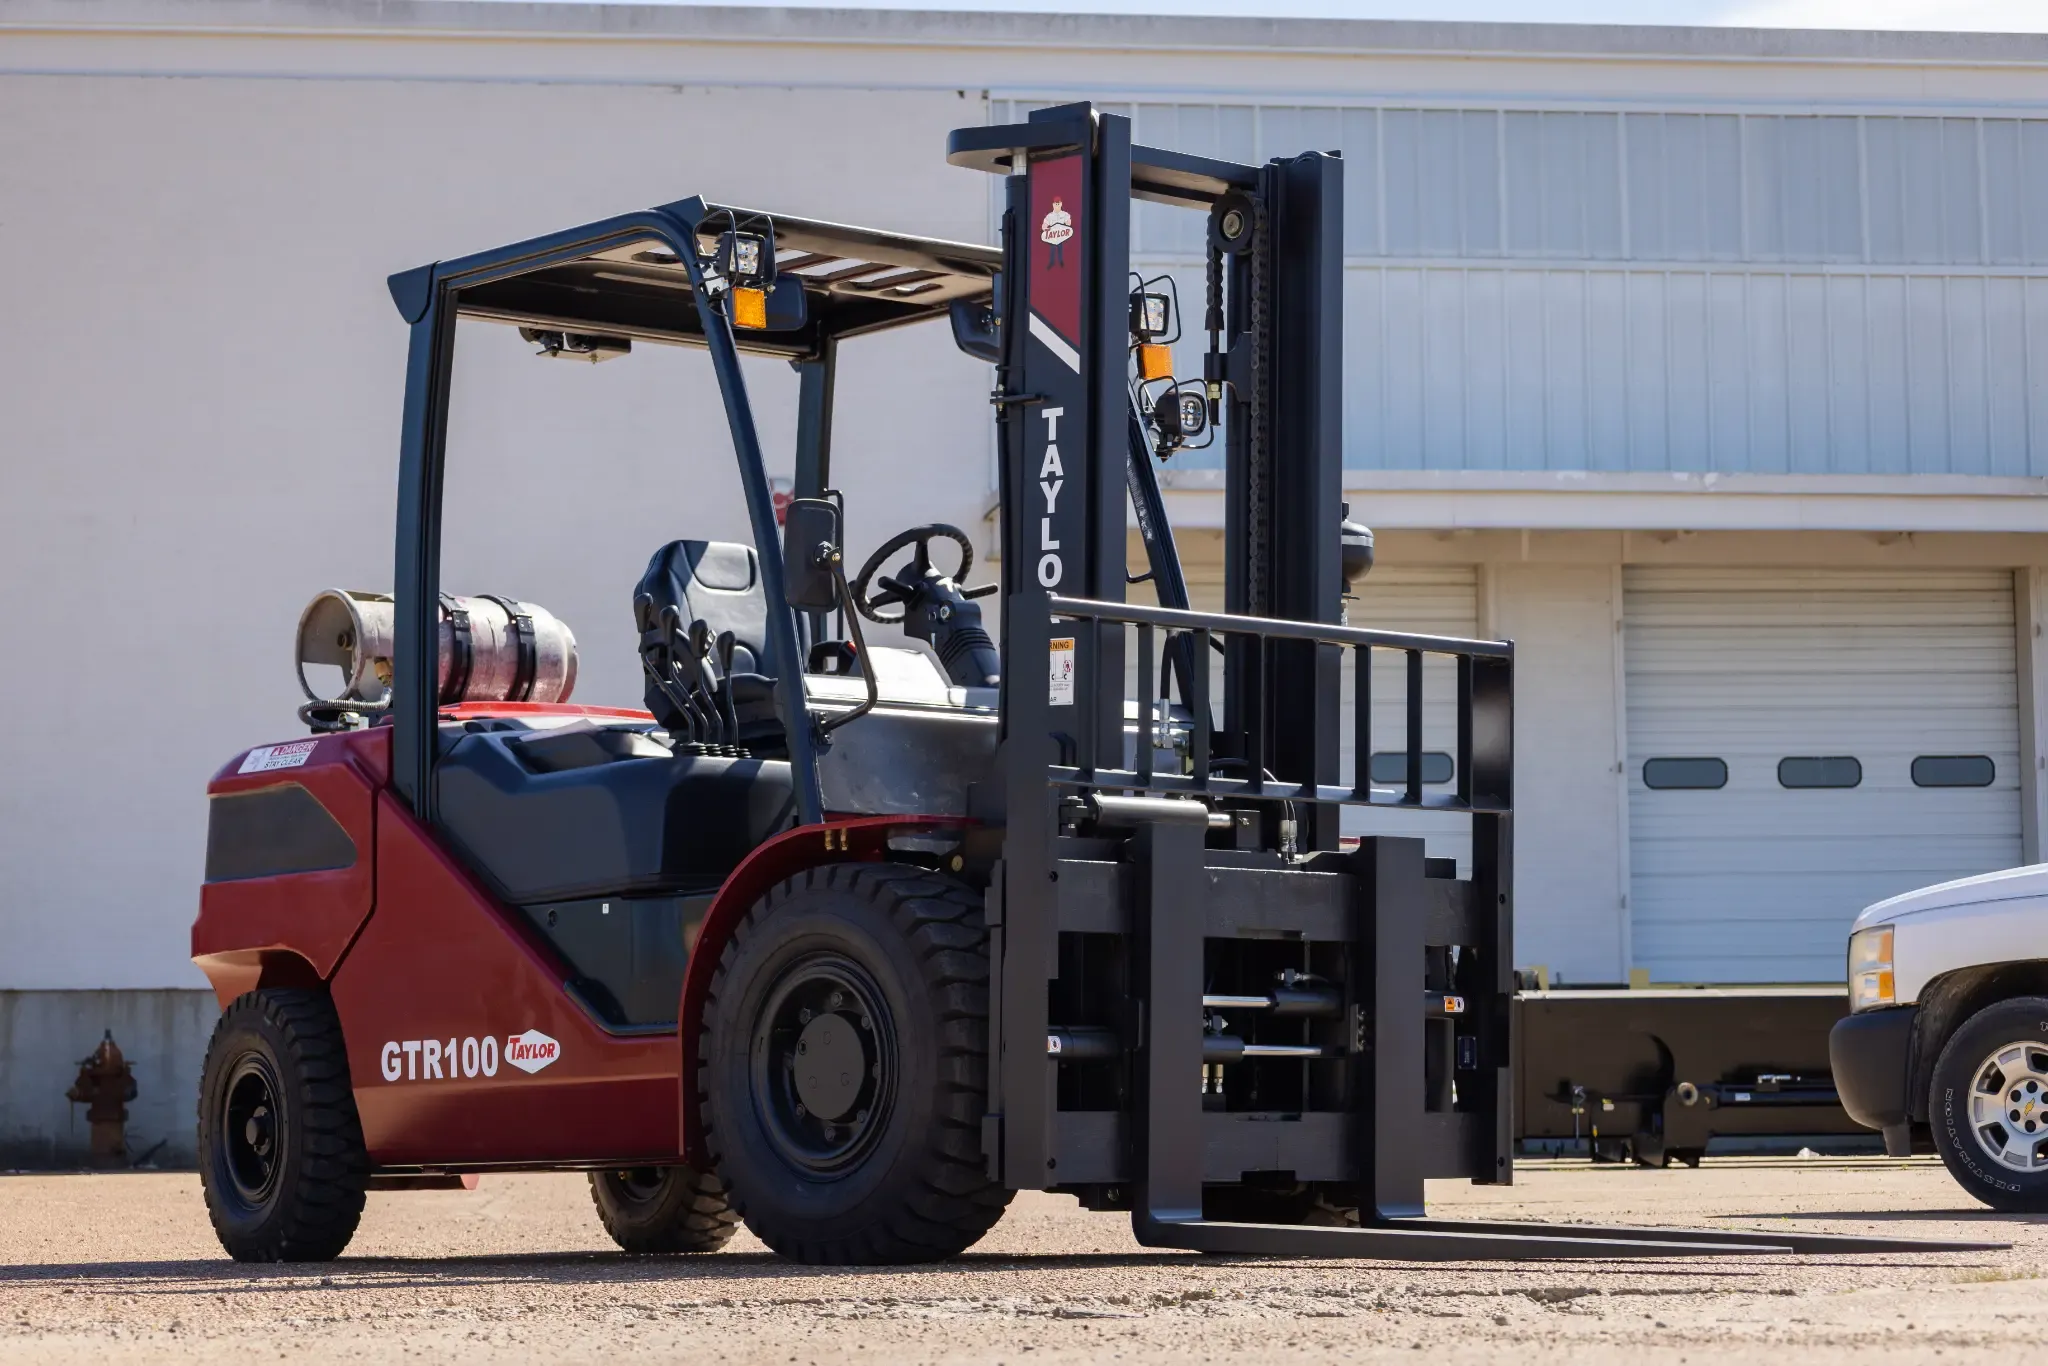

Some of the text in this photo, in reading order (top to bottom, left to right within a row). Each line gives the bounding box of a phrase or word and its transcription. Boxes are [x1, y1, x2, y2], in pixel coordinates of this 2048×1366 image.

[1045, 229, 1070, 239] TAYLOR
[1037, 407, 1064, 600] TAYLO
[1050, 641, 1069, 650] RNING
[280, 743, 316, 755] DANGER
[264, 761, 281, 769] STAY
[281, 757, 303, 767] CLEAR
[381, 1035, 556, 1082] GTR100 TAYLOR
[1944, 1088, 2021, 1192] DESTINATION
